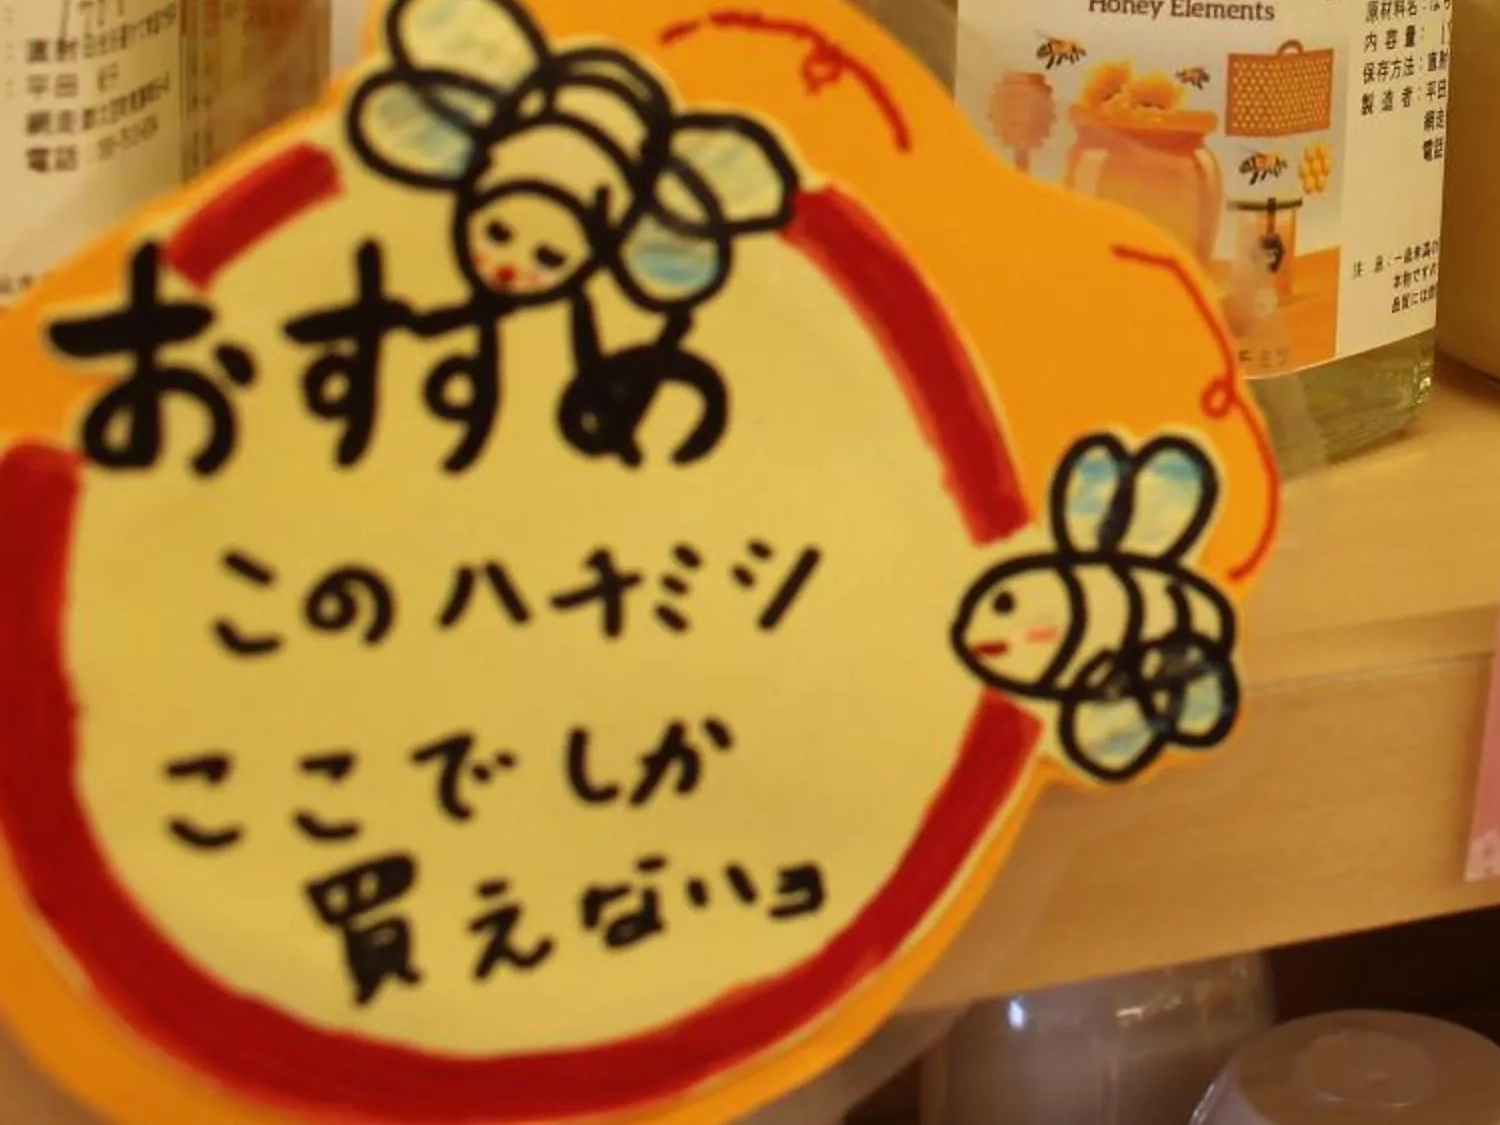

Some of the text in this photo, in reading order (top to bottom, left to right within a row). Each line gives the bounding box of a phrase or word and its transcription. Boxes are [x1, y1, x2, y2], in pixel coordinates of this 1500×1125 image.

[44, 236, 730, 477] おすすめ
[163, 717, 734, 850] ここでしか
